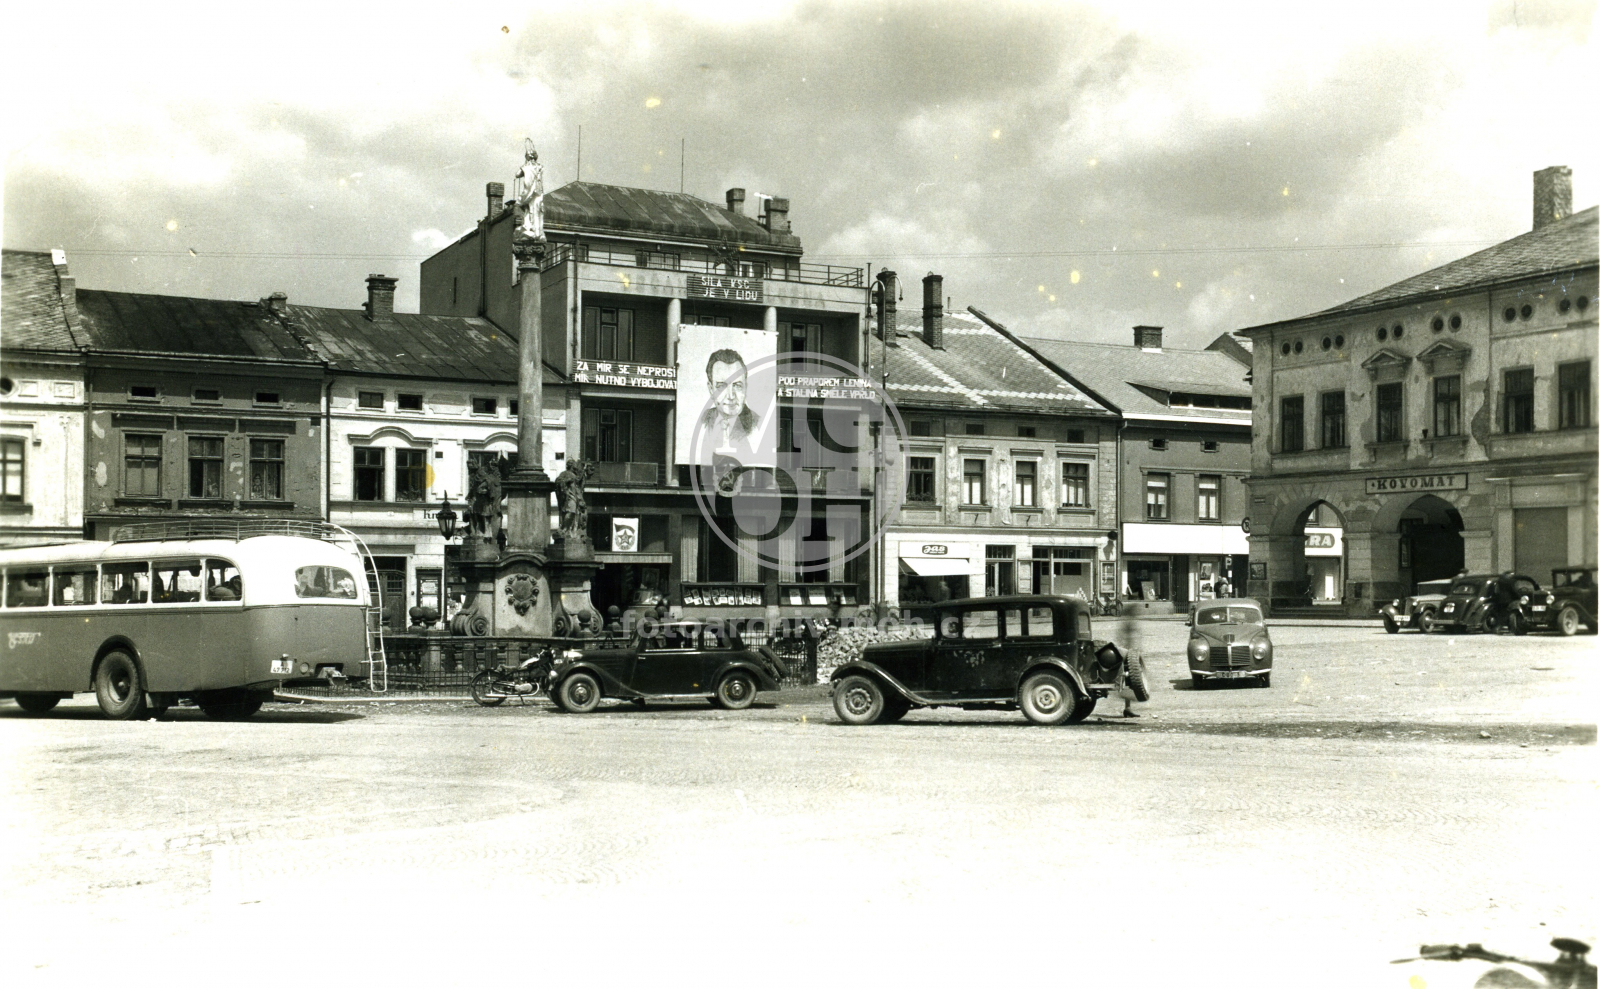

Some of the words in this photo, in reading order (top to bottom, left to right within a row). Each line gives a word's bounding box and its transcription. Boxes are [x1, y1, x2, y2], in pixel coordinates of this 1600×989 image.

[703, 287, 716, 298] JE
[723, 289, 730, 299] V
[735, 290, 758, 301] LIDU
[576, 361, 589, 371] ZA
[596, 360, 612, 373] MÍR
[618, 364, 631, 375] SE
[636, 365, 676, 378] NEPROSÍ
[574, 371, 590, 383] MÍR
[595, 374, 627, 386] NUTNO
[778, 376, 796, 386] POD
[798, 377, 840, 388] PRAPOREM
[843, 378, 872, 388] LENINA
[777, 388, 784, 397] A
[786, 388, 819, 398] STALINA
[1377, 476, 1456, 490] KOVOMAT
[1305, 534, 1332, 547] RA
